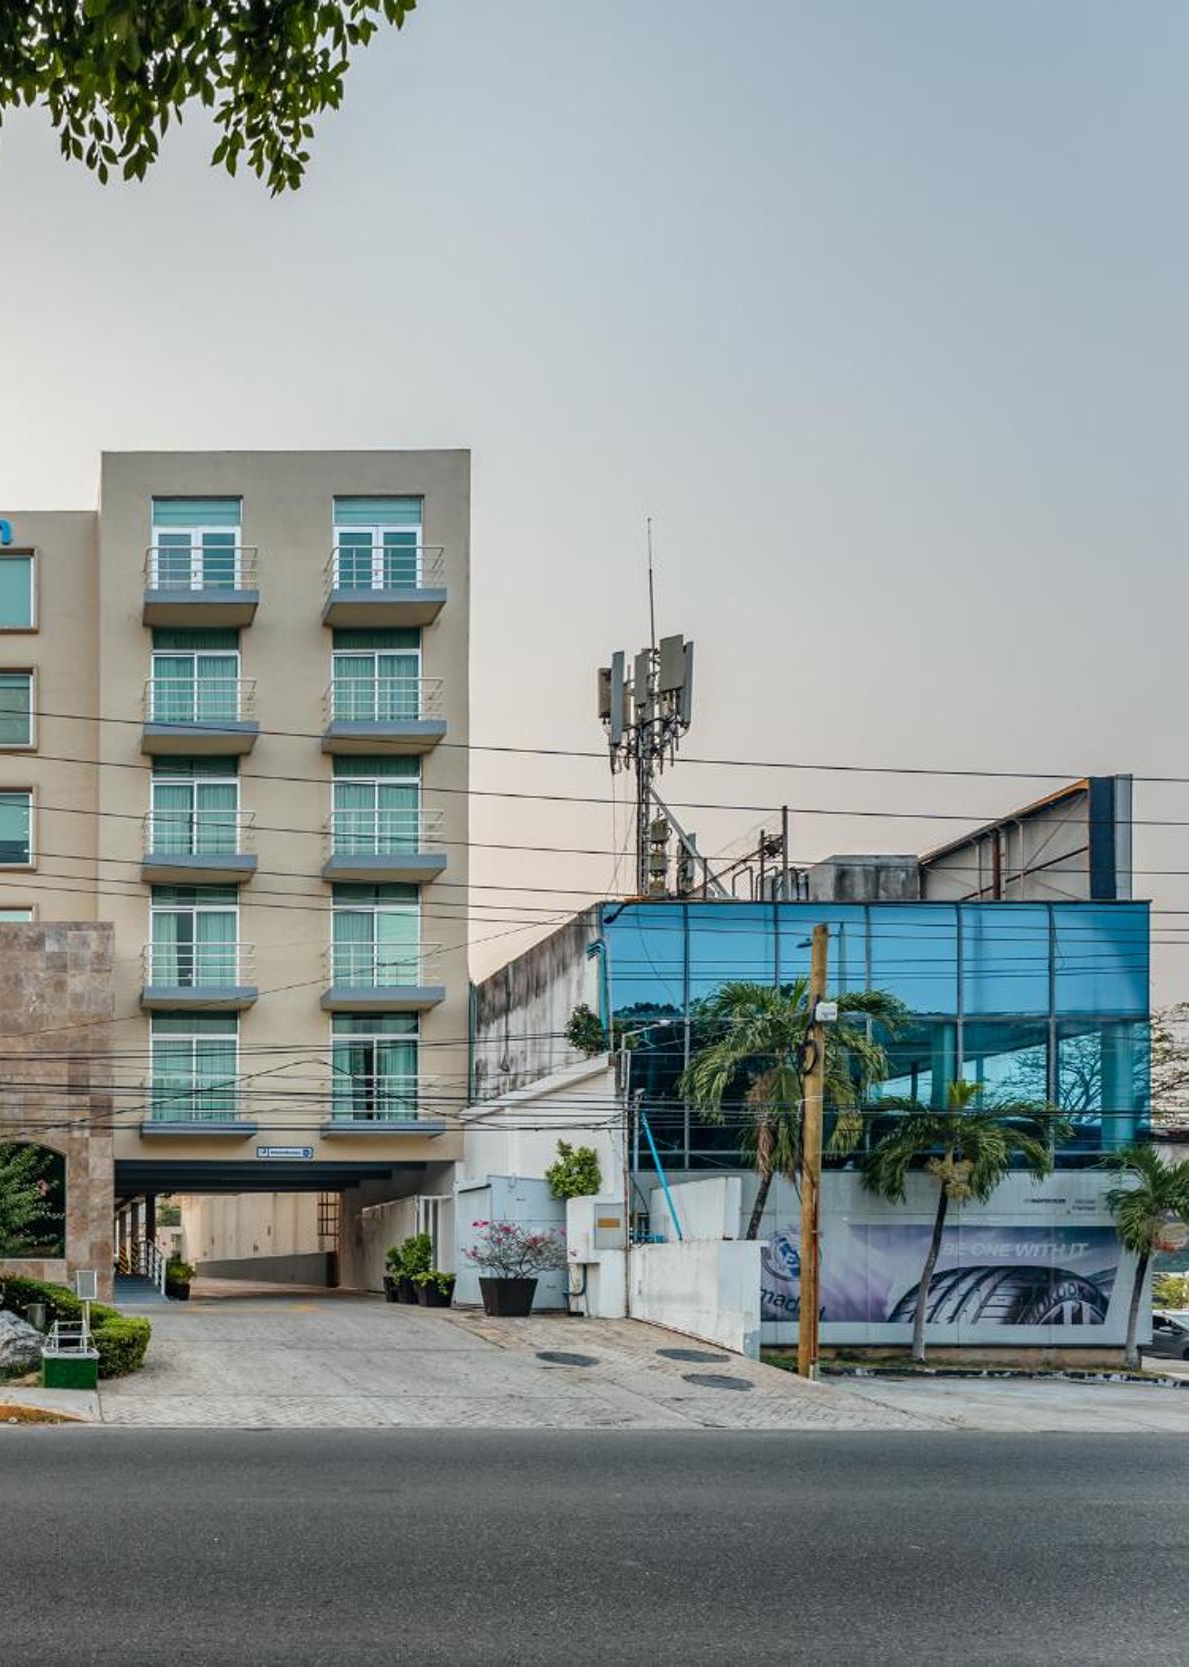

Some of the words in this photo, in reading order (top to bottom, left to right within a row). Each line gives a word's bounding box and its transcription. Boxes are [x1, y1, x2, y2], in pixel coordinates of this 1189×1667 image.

[942, 1242, 969, 1256] BE
[970, 1242, 1010, 1257] ONE
[1015, 1243, 1066, 1257] WITH
[1068, 1243, 1089, 1256] IT
